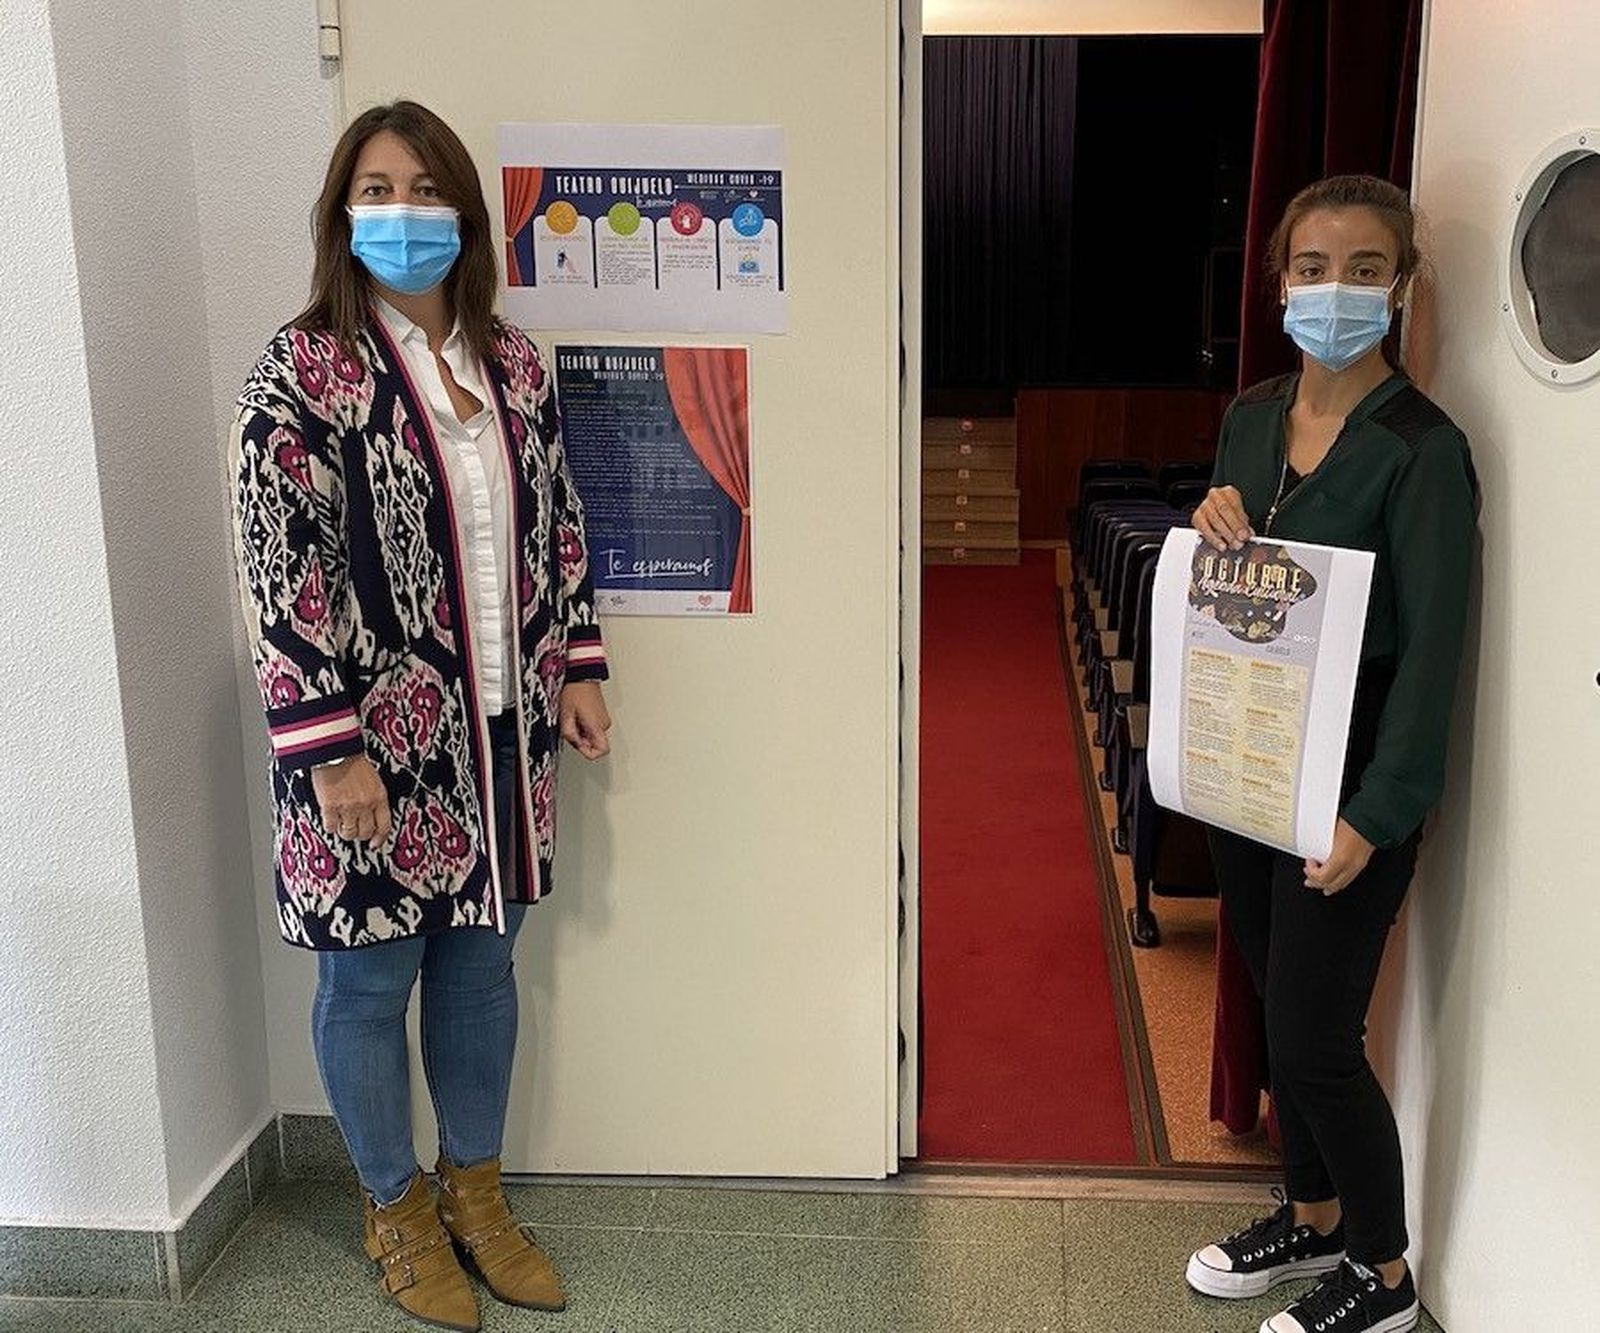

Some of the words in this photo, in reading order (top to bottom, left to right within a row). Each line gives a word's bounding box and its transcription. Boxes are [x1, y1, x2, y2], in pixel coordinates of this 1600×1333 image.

[556, 176, 602, 194] TEATRO
[560, 355, 599, 370] TEATRO
[600, 549, 626, 576] Te
[632, 558, 714, 578] esperamos
[1203, 555, 1302, 592] OCTUBRE
